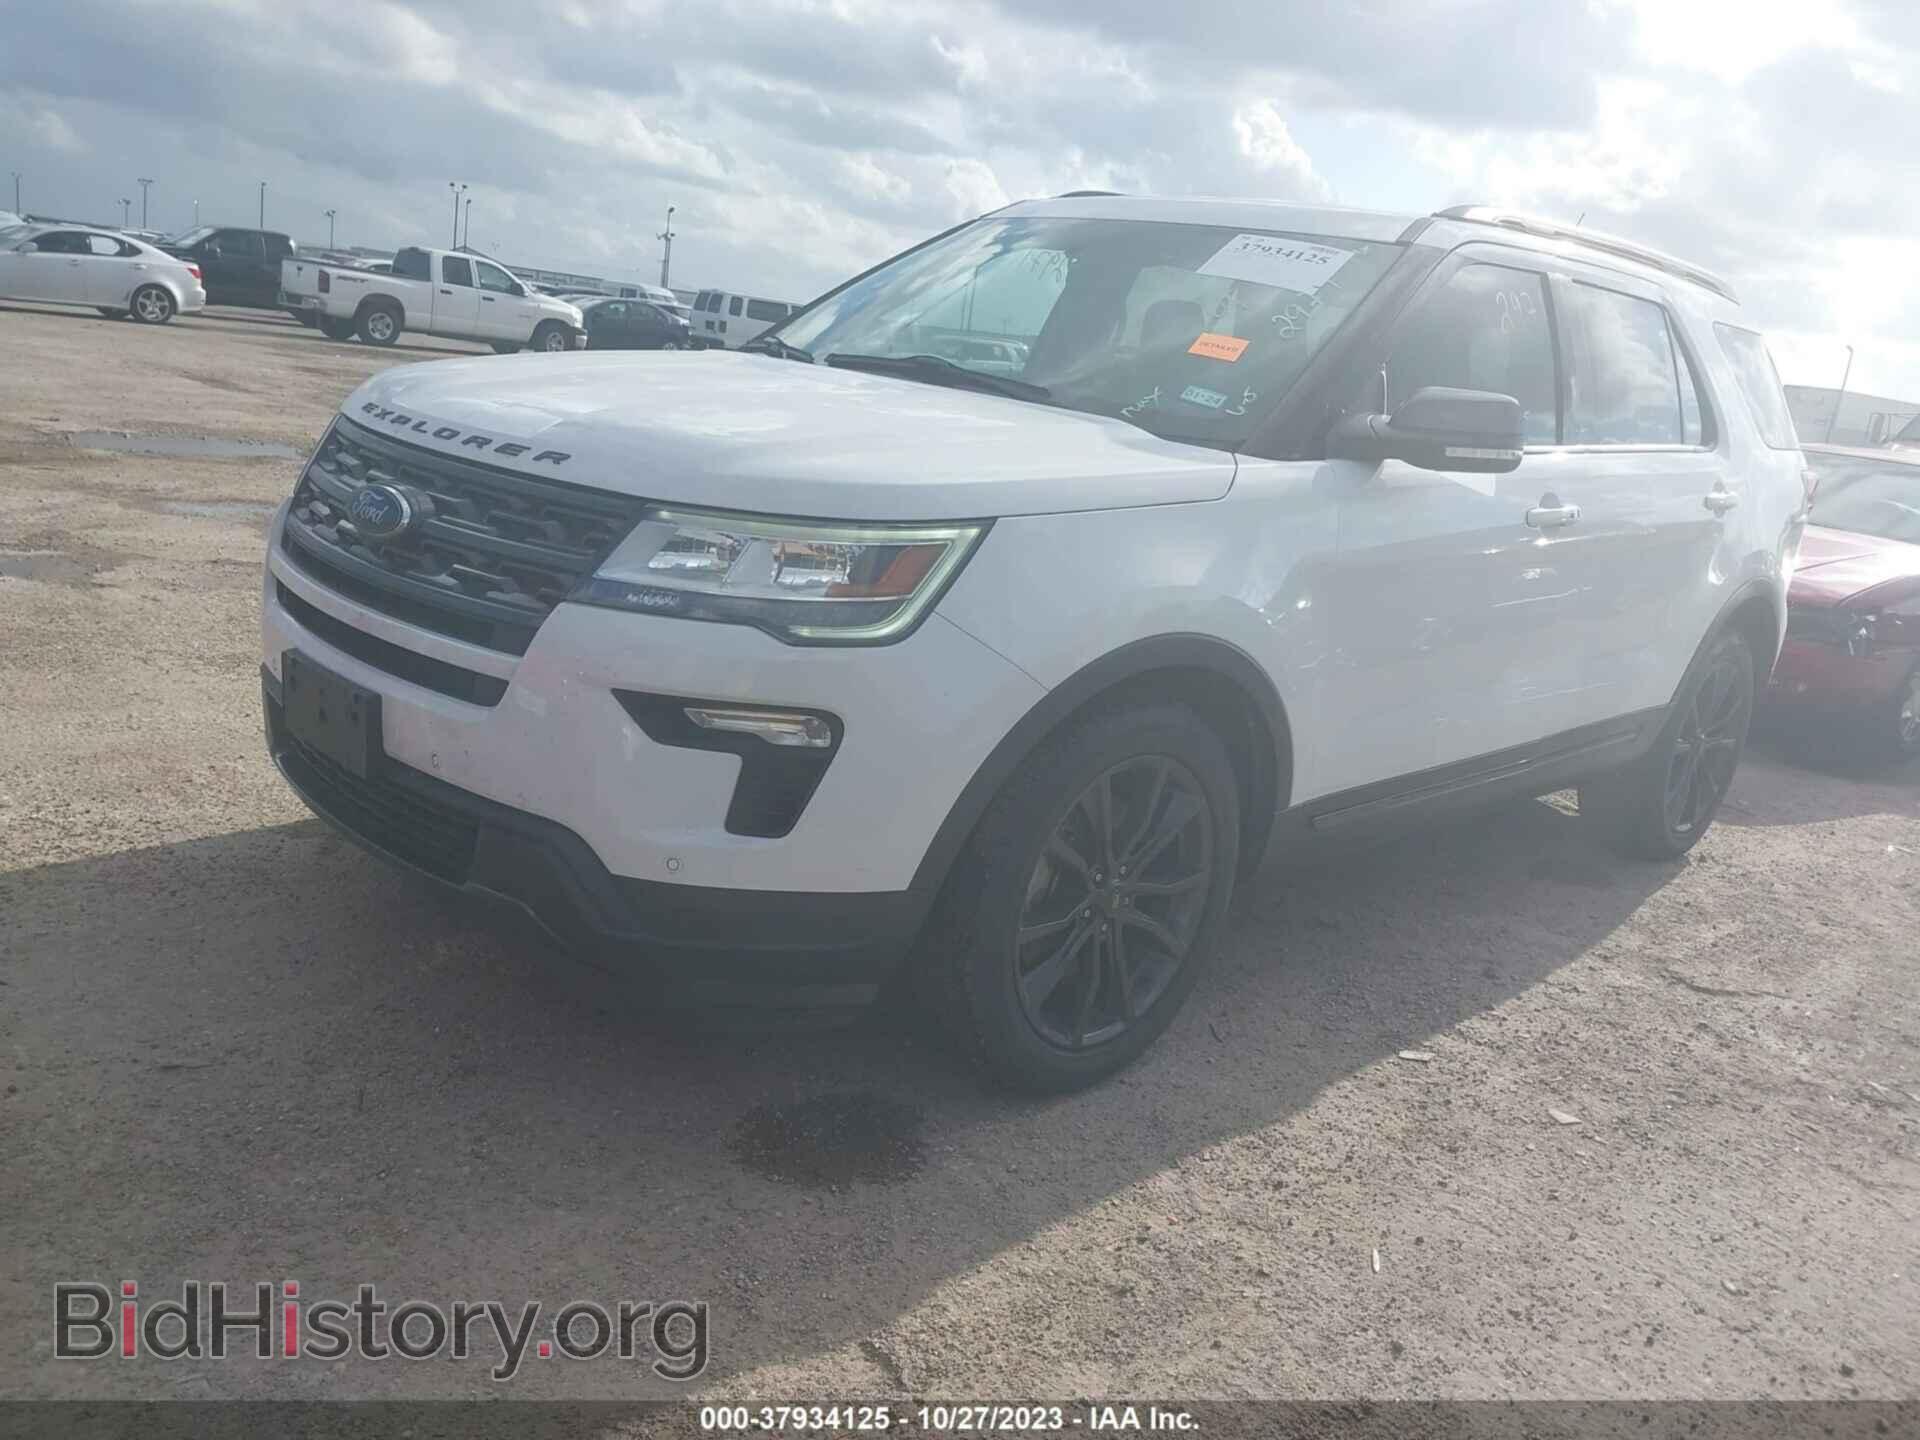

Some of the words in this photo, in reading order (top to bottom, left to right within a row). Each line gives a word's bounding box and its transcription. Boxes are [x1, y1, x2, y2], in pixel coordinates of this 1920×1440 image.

[1233, 241, 1331, 265] 37934125
[360, 402, 572, 466] EXPLORER
[352, 489, 390, 527] Ford
